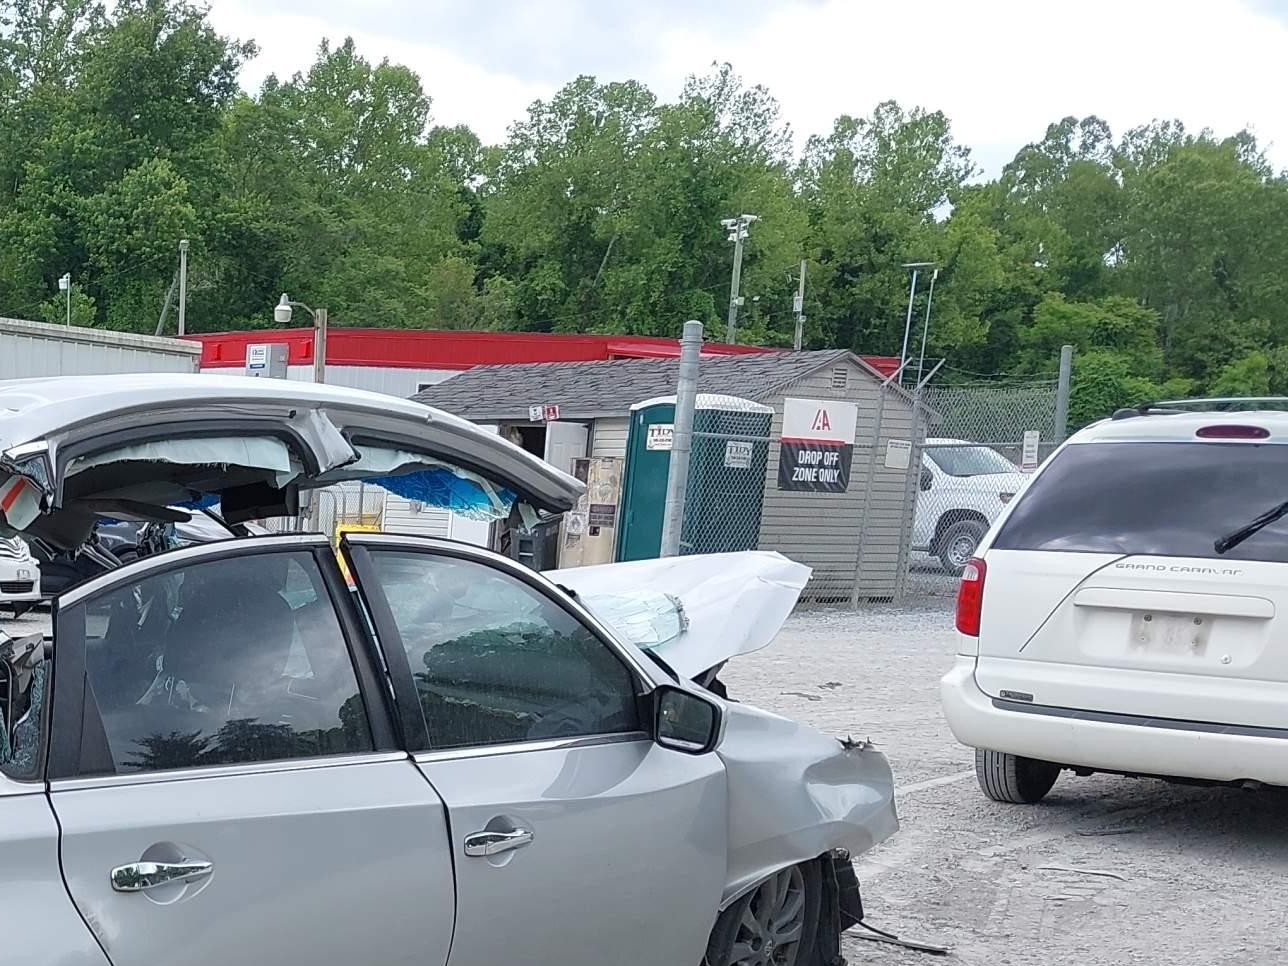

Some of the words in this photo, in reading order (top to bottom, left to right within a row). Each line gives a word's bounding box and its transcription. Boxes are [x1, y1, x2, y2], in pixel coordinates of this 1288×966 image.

[728, 445, 752, 456] TIDY
[798, 450, 823, 465] DROP
[823, 451, 839, 466] OFF
[792, 467, 818, 482] ZONE
[818, 468, 840, 483] ONLY
[1115, 563, 1167, 571] GRAND
